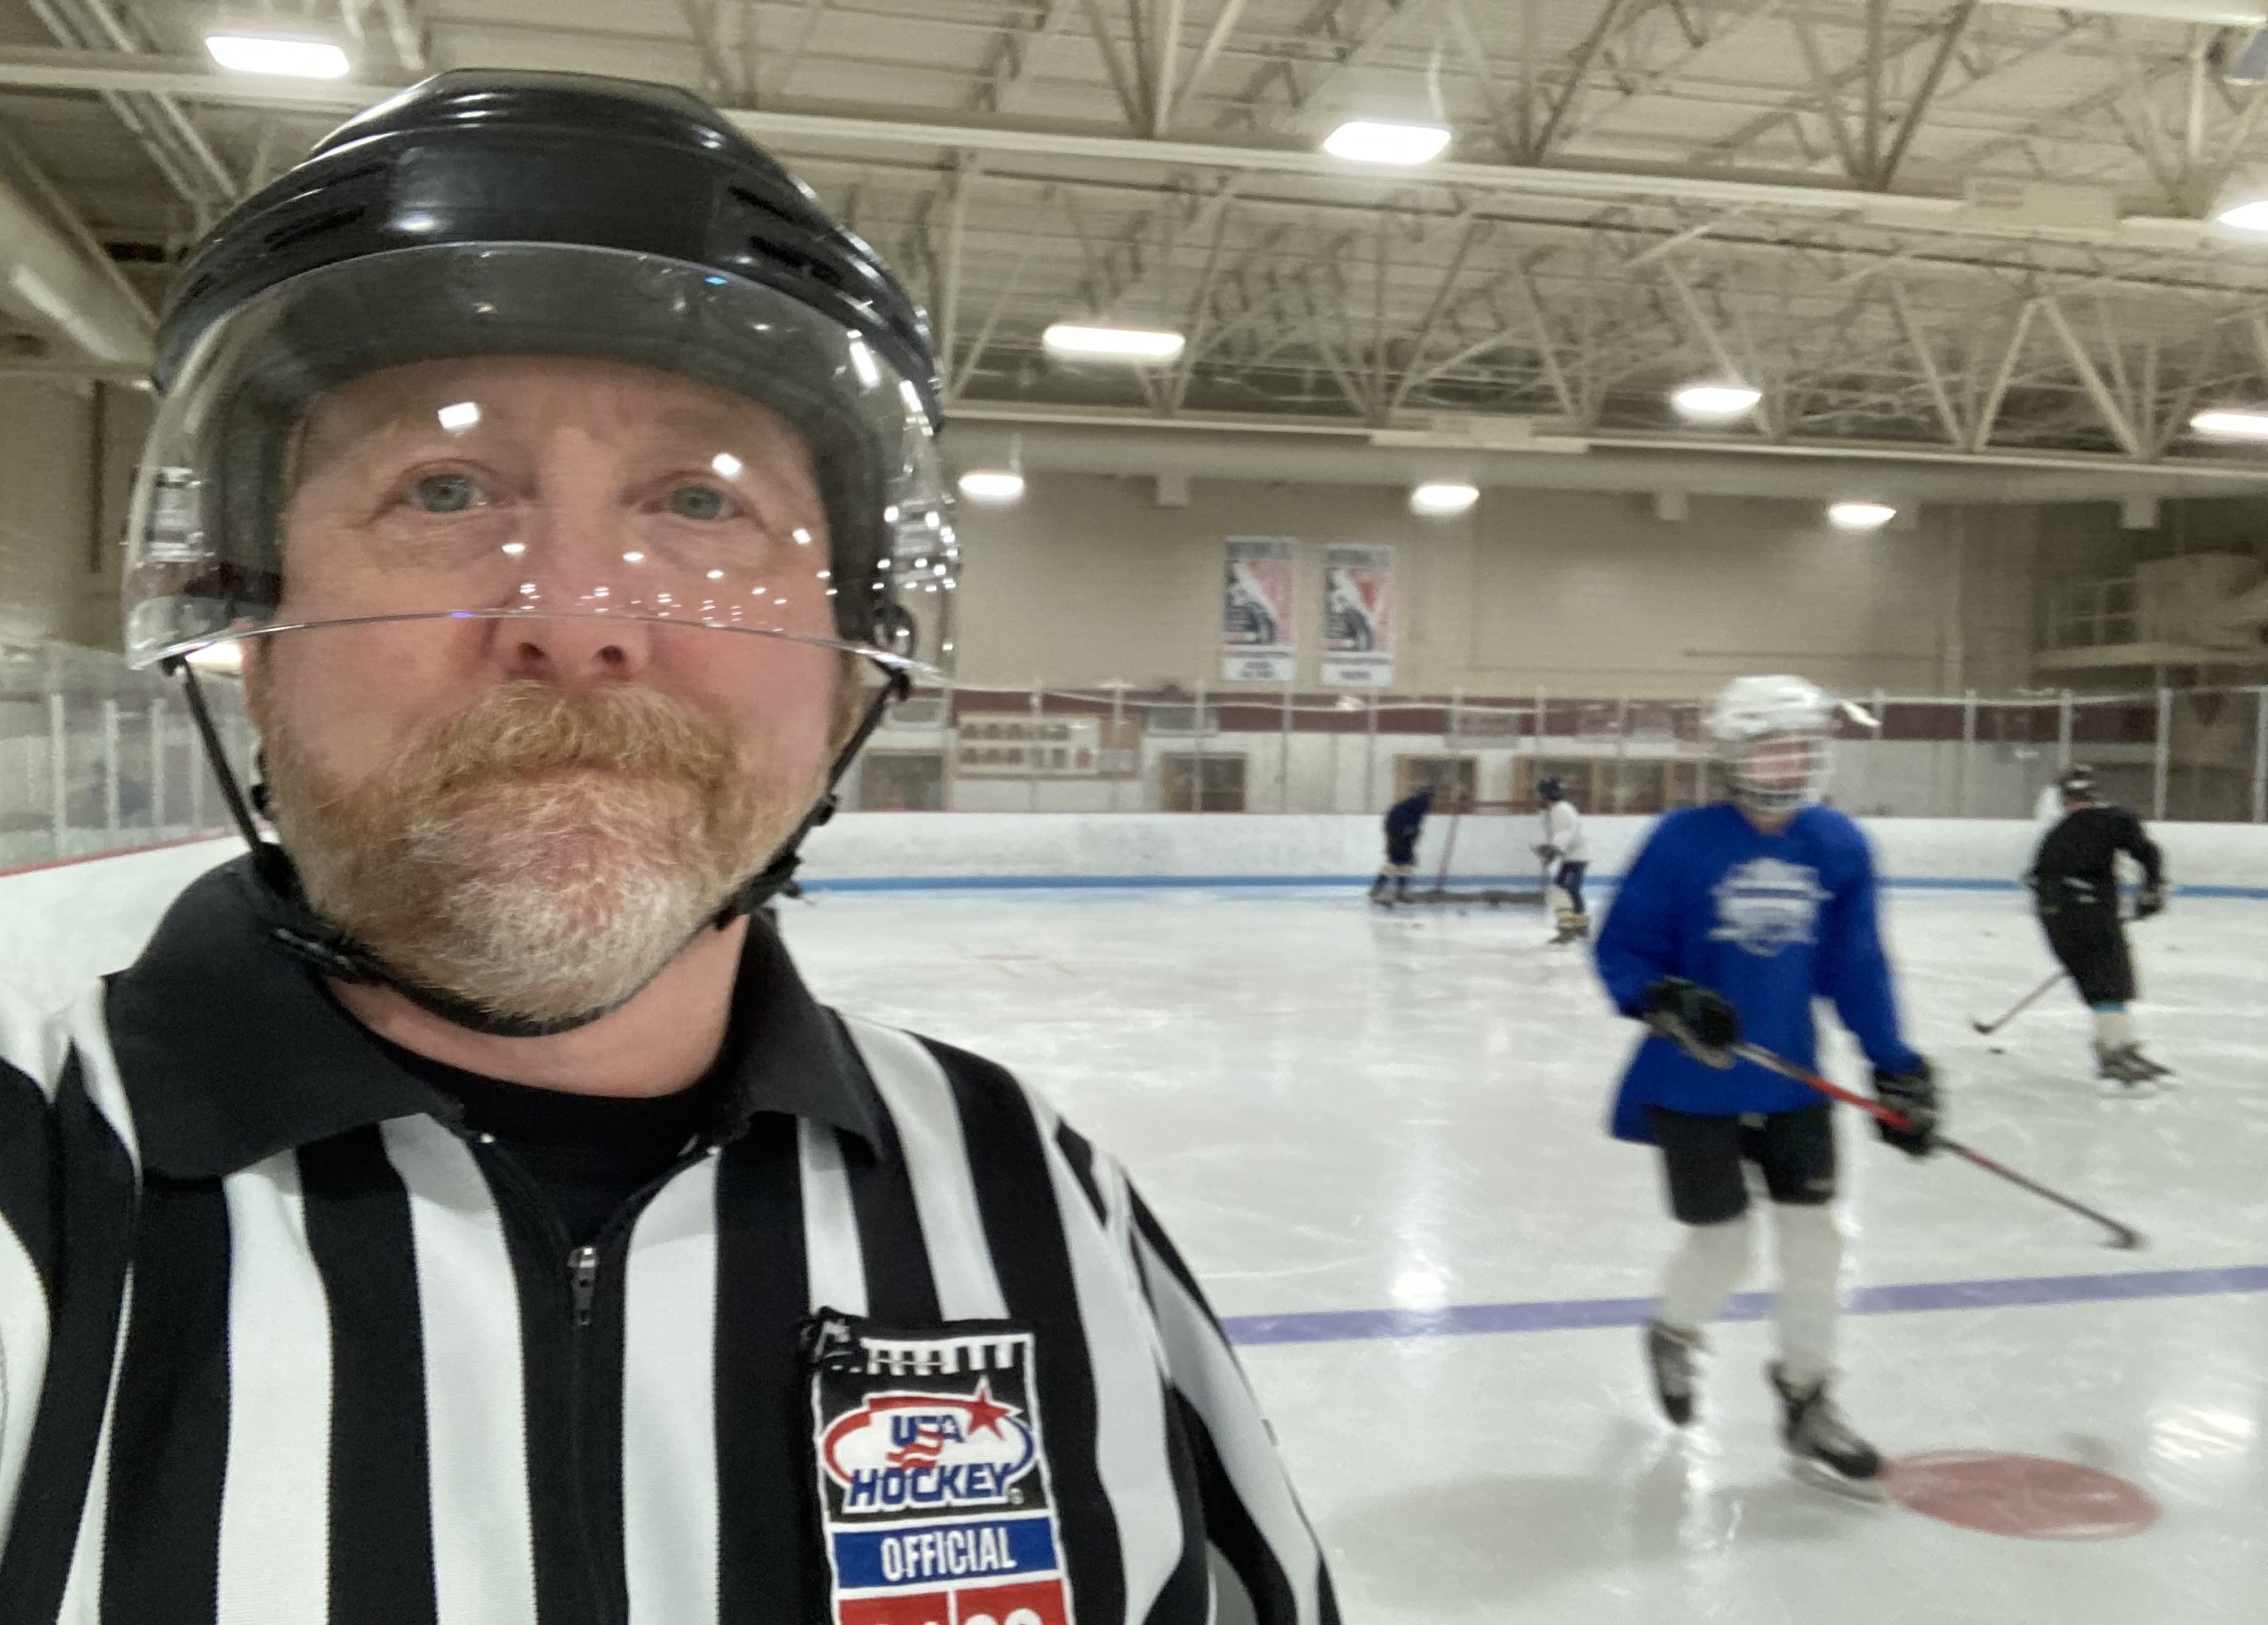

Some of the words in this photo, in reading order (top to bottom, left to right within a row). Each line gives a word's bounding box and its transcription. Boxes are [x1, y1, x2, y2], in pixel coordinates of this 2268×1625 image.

[889, 1414, 964, 1464] USA
[849, 1463, 1011, 1505] HOCKEY
[882, 1528, 1016, 1582] OFFICIAL
